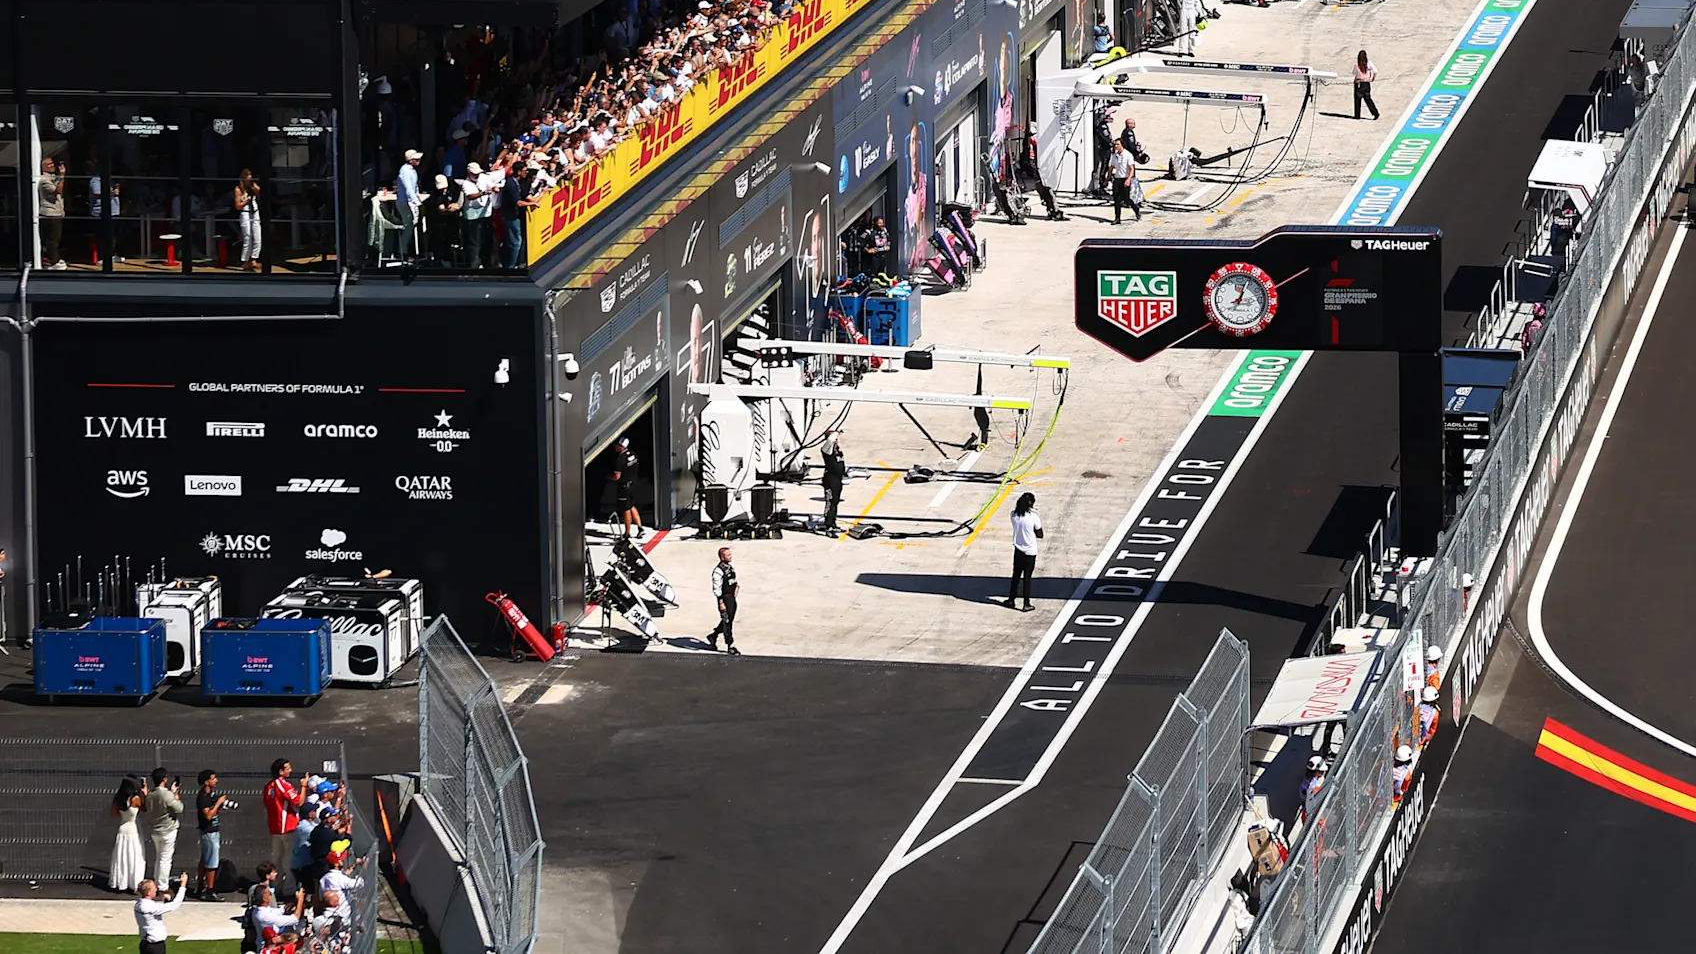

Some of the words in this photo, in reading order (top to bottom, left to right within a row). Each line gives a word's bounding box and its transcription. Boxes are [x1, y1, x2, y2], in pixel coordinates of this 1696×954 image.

[1467, 15, 1511, 45] aramco
[1441, 53, 1487, 86] aramco
[1413, 94, 1460, 129] aramco
[750, 147, 777, 177] CADILLAC
[863, 146, 880, 169] GASLY
[1380, 137, 1432, 176] aramco
[551, 161, 603, 238] DHL
[1346, 185, 1401, 226] aramco
[753, 242, 775, 270] PEREZ
[1365, 240, 1430, 251] TAGHeuer
[619, 253, 650, 288] CADILLAC
[1104, 275, 1169, 295] TAG
[1102, 299, 1173, 330] HEUER
[189, 383, 229, 392] GLOBAL
[231, 383, 284, 393] PARTNERS
[286, 384, 300, 393] OF
[302, 384, 353, 394] FORMULA
[609, 361, 621, 395] 77
[621, 354, 651, 389] BOTTAS
[1223, 355, 1290, 409] aramco
[1557, 356, 1591, 466] TAGHeuer
[84, 416, 168, 440] LVMH
[206, 421, 265, 437] PIRELLI
[304, 424, 378, 439] aramco
[417, 427, 469, 440] Heineken
[106, 470, 148, 486] aws
[190, 479, 236, 492] Lenovo
[285, 478, 351, 494] DHL
[395, 475, 452, 492] QATAR
[409, 489, 454, 501] AIRWAYS
[1514, 453, 1551, 576] TAGHeuer
[224, 534, 271, 552] MSC
[305, 547, 362, 563] salesforce
[1020, 660, 1095, 712] ALL
[1062, 614, 1125, 643] TO
[1094, 516, 1187, 596] DRIVE
[1157, 458, 1225, 501] FOR
[1462, 565, 1507, 704] TAGHeuer
[1407, 674, 1421, 682] FIRE
[1384, 773, 1425, 894] TAGHeuer
